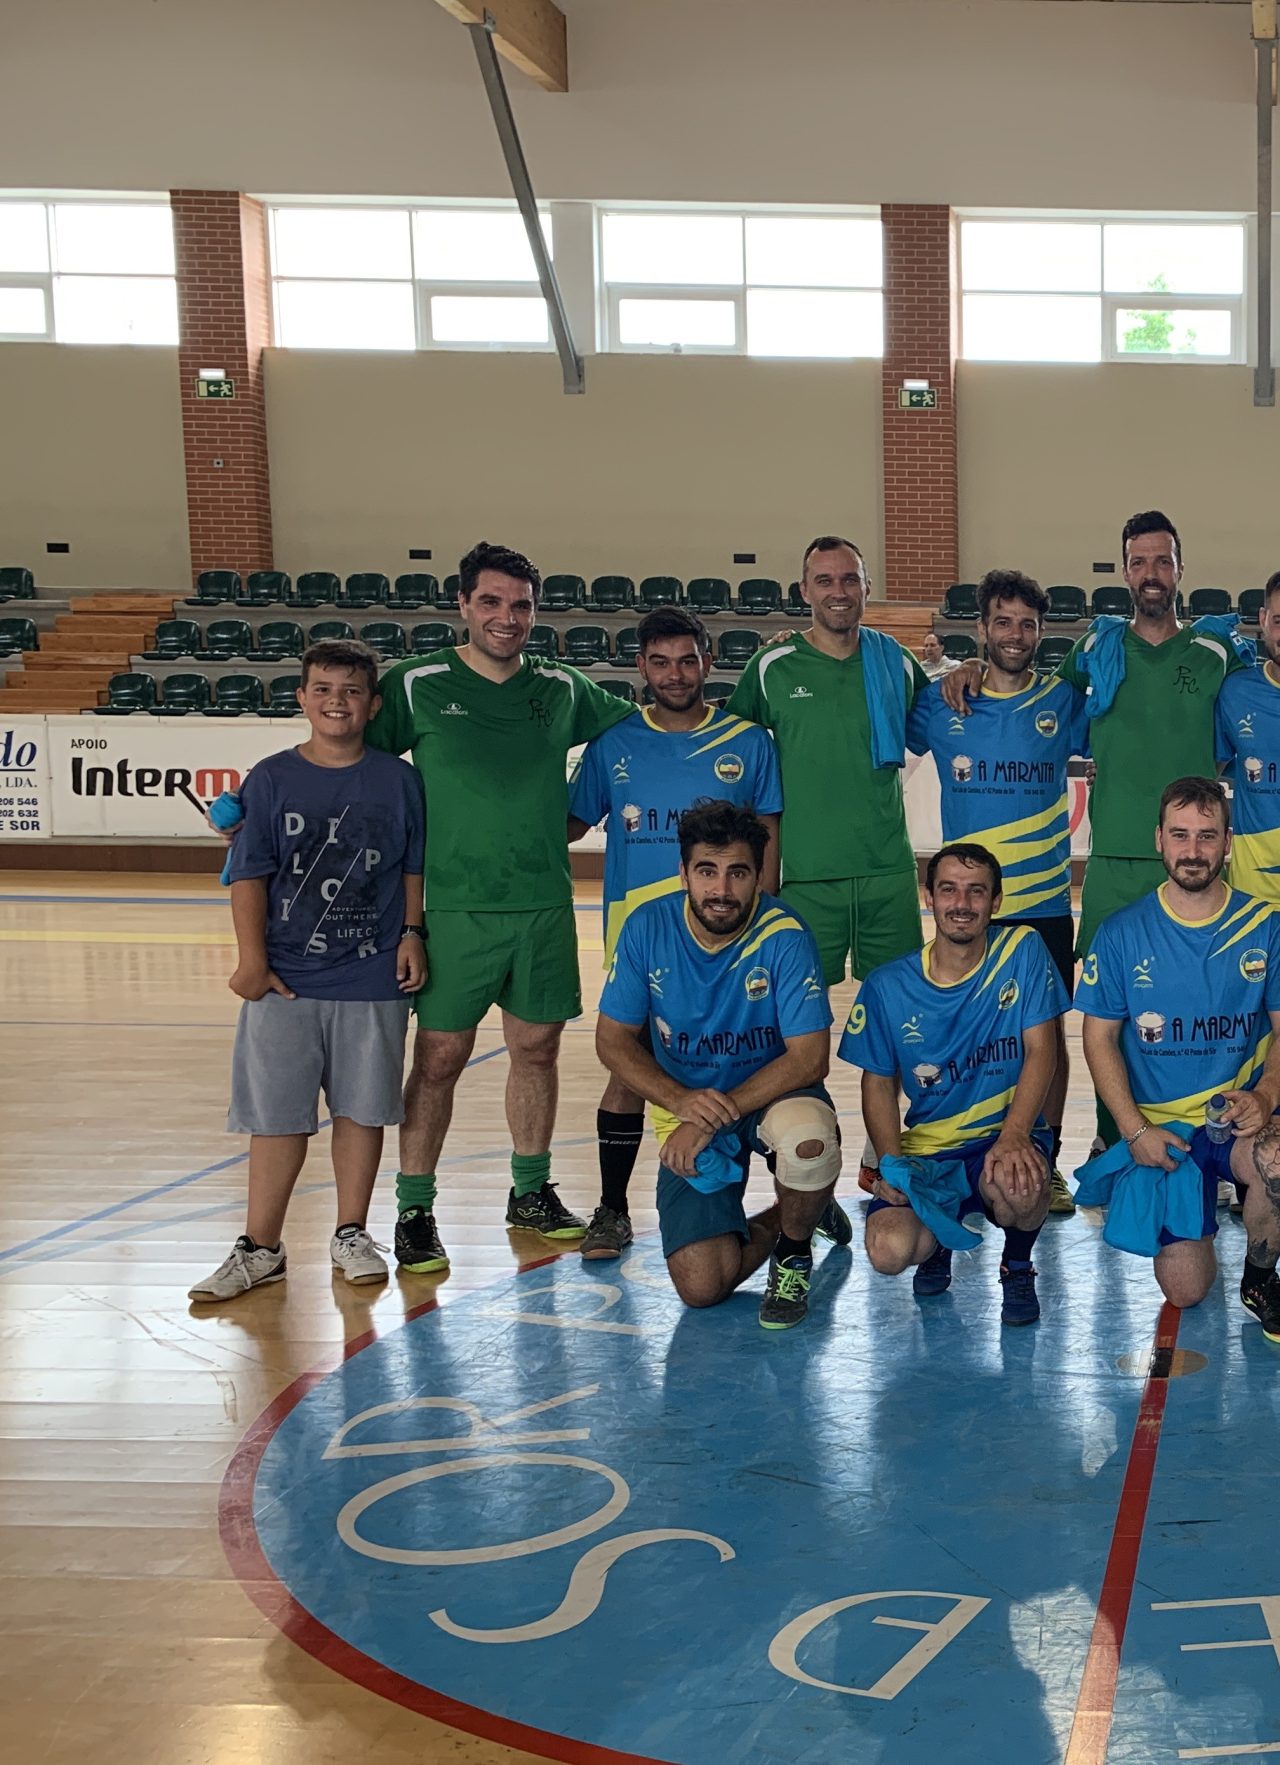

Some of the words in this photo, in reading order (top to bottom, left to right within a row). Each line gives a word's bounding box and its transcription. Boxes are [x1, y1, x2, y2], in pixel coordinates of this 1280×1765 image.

[70, 738, 107, 750] APOIO
[978, 760, 987, 782] A
[993, 760, 1055, 784] MARMITA
[1267, 762, 1277, 783] A
[6, 777, 37, 788] LDA.
[17, 797, 38, 805] 546
[18, 809, 39, 817] 632
[647, 808, 658, 831] A
[9, 820, 40, 831] SOR
[325, 913, 344, 921] OUT
[337, 928, 364, 938] LIFE
[1082, 952, 1099, 986] 3
[846, 1003, 867, 1035] 9
[1172, 1016, 1184, 1042] A
[1191, 1011, 1258, 1042] MARMIT
[678, 1031, 689, 1056] A
[696, 1025, 777, 1056] MARMITA
